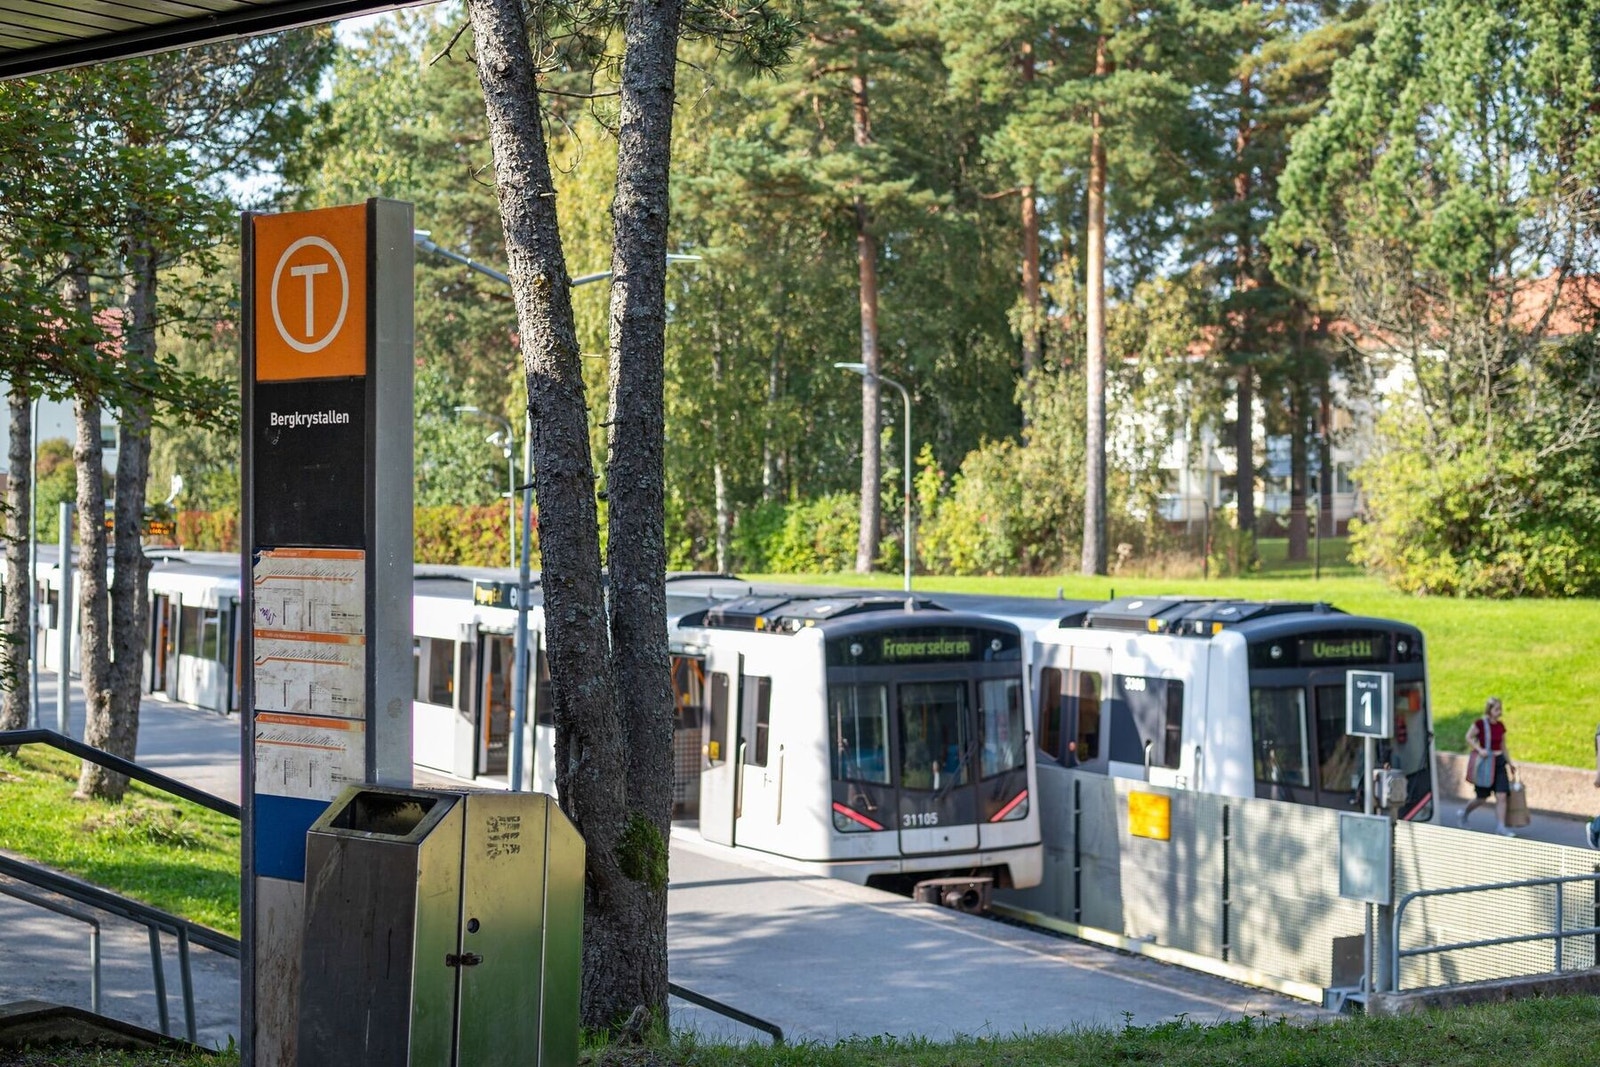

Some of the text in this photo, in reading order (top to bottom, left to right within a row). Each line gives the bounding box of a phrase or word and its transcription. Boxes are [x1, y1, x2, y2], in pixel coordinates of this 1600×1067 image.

[290, 263, 329, 337] T
[270, 410, 350, 428] Bergkrystallen
[1360, 691, 1372, 727] 1
[902, 812, 938, 827] 31105
